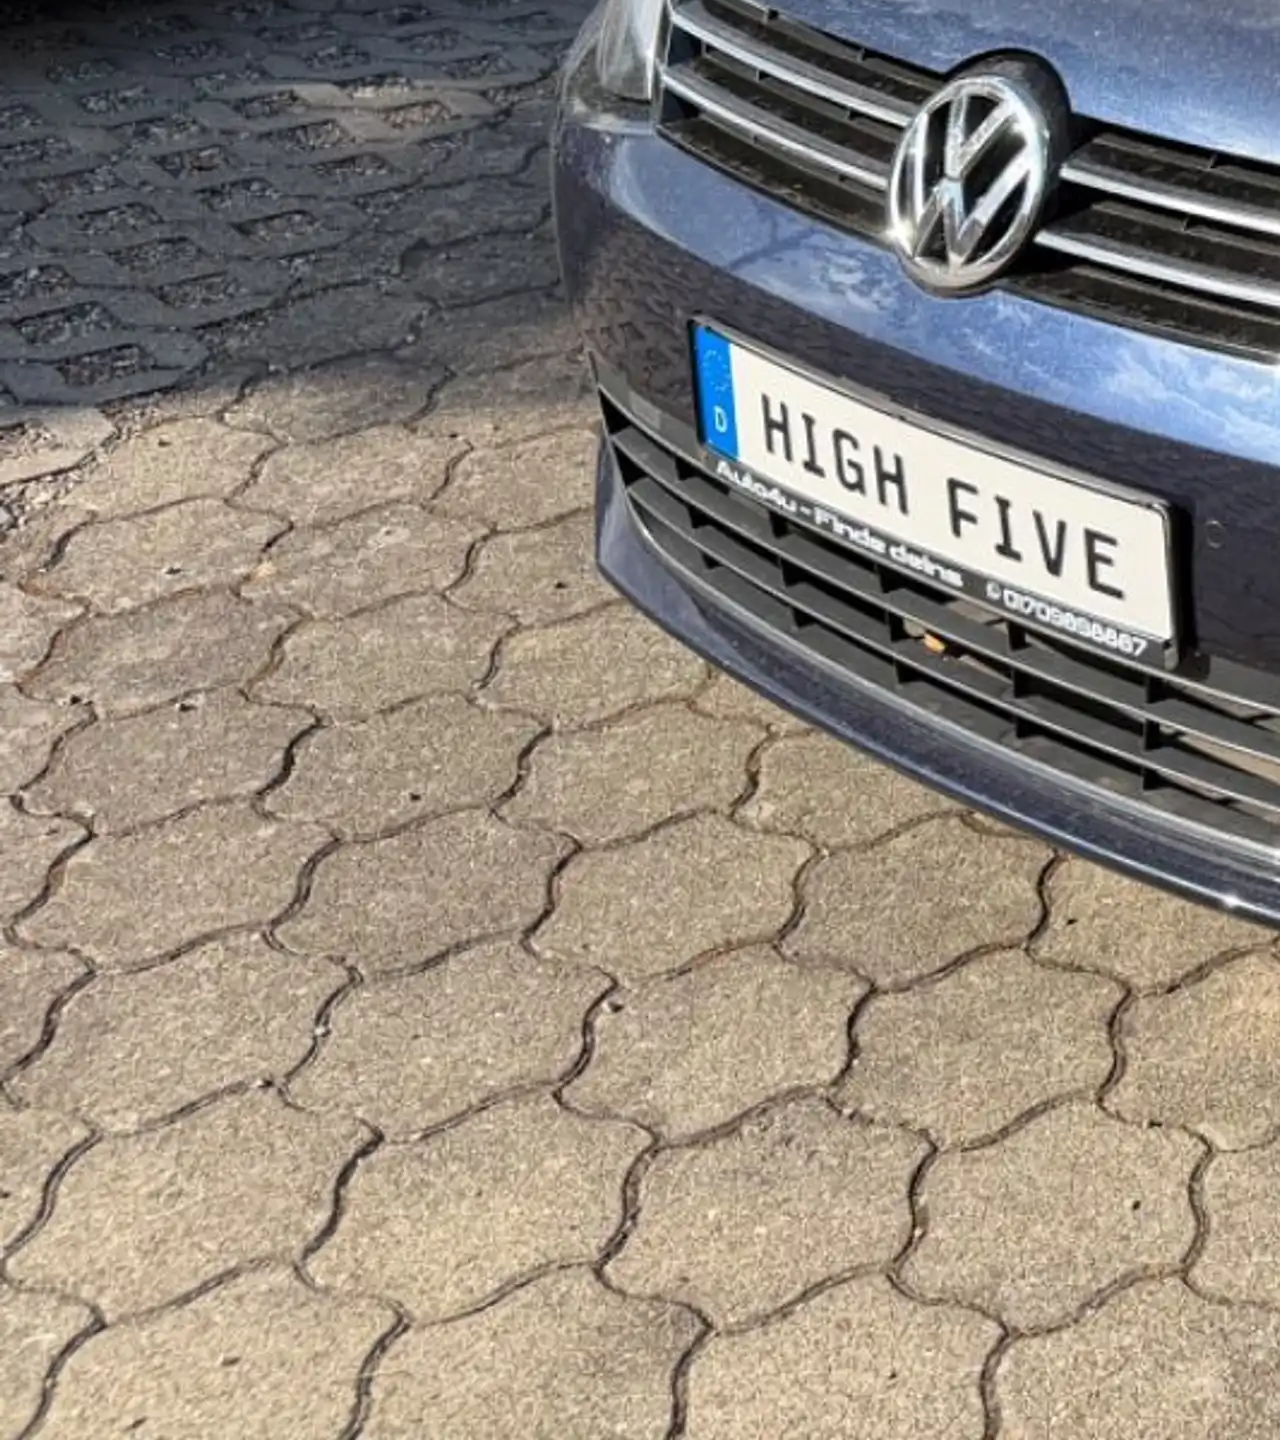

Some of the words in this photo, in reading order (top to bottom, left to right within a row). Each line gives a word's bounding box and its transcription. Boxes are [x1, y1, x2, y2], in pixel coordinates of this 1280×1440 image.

[714, 405, 727, 435] D
[760, 392, 909, 515] HIGH
[946, 476, 1127, 600] FIVE
